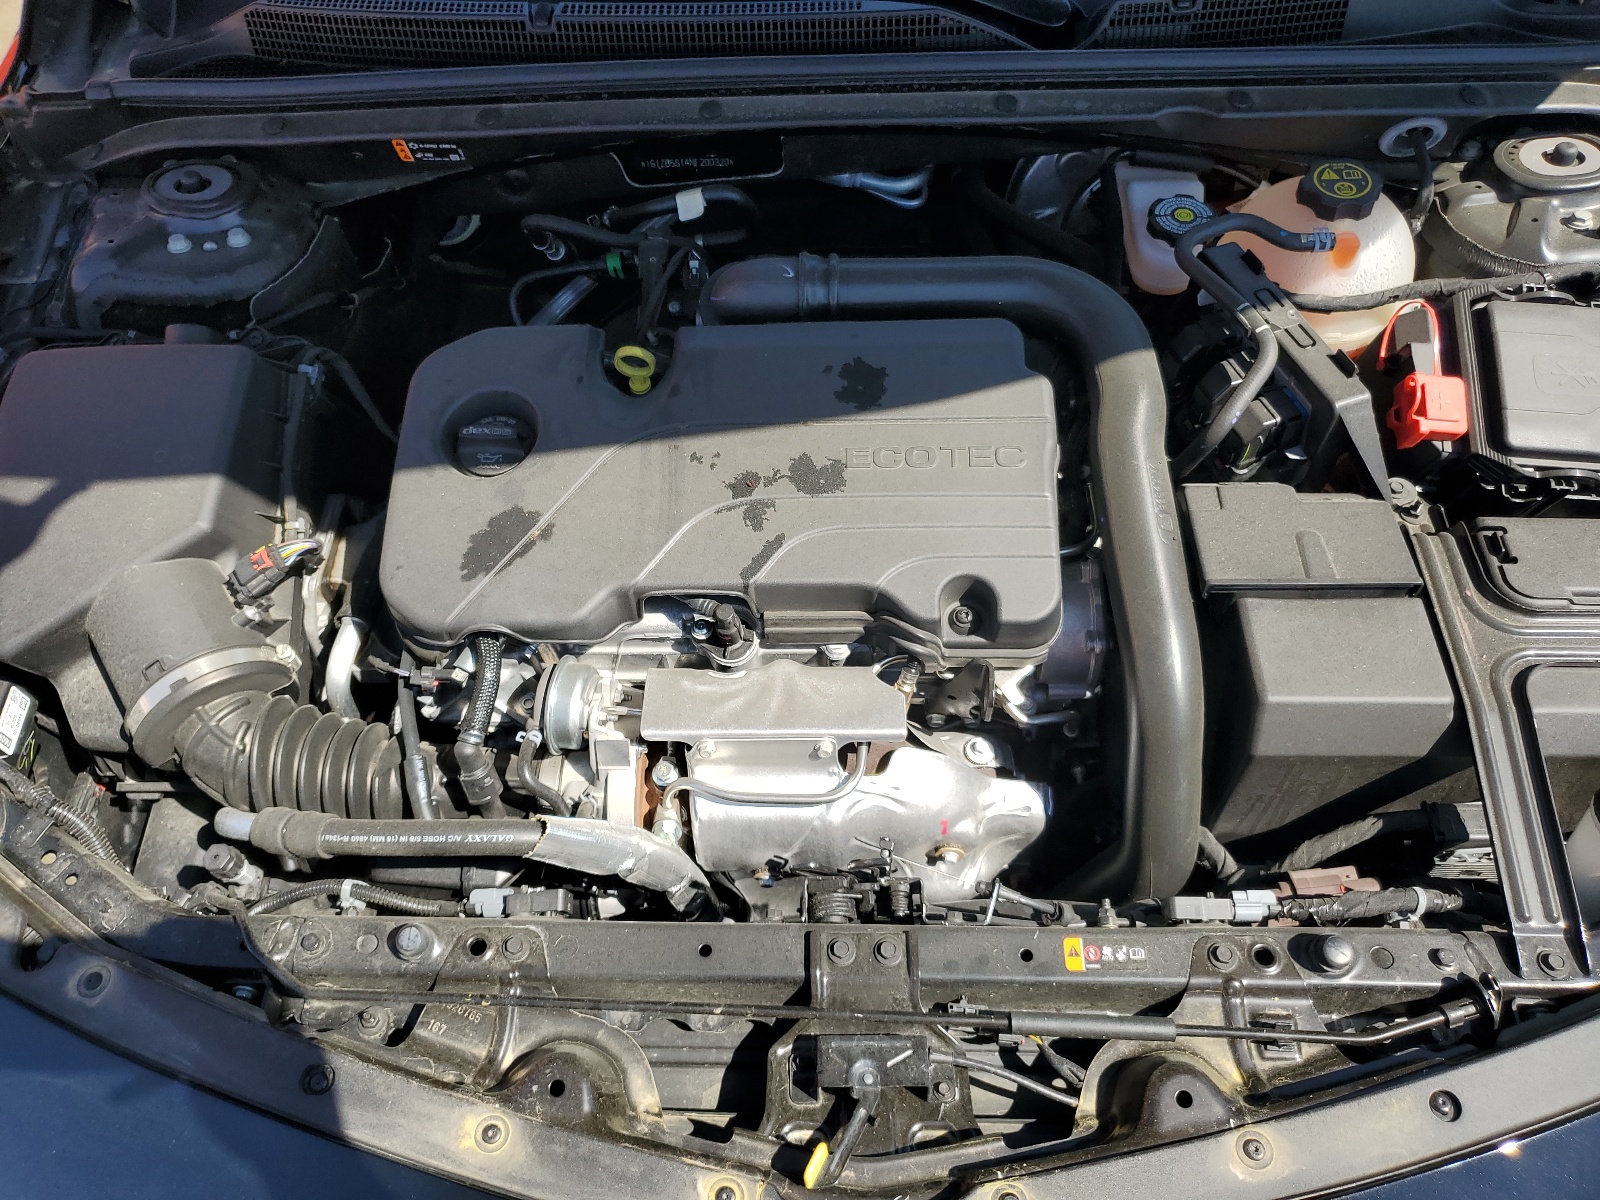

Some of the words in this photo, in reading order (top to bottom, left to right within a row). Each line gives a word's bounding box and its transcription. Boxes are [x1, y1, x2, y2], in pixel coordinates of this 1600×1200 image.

[845, 446, 1028, 470] ECOTEC
[422, 834, 446, 843] HOSE
[448, 834, 462, 842] A/C
[464, 834, 514, 843] GALAXY
[427, 1019, 447, 1035] 167
